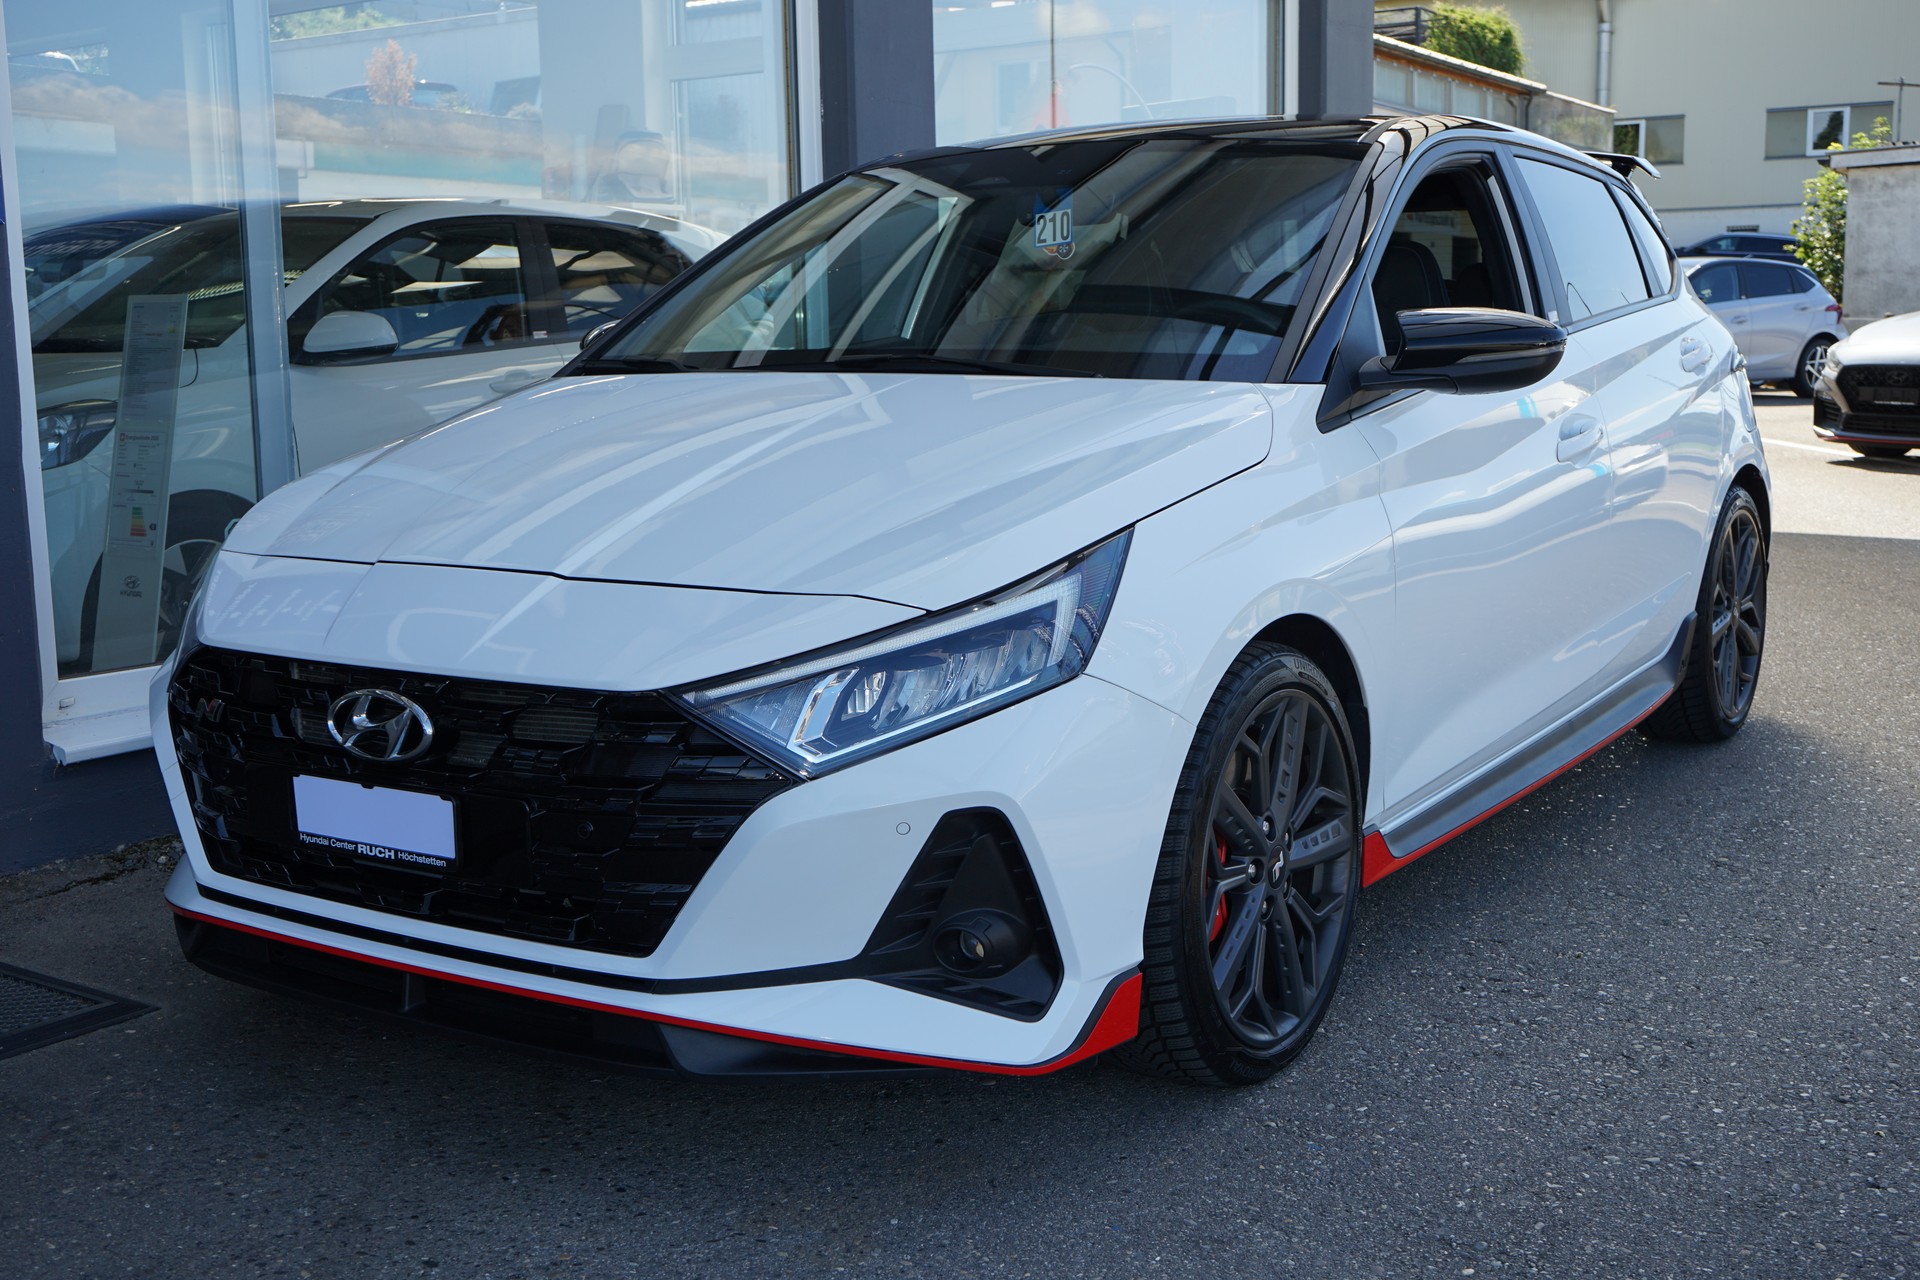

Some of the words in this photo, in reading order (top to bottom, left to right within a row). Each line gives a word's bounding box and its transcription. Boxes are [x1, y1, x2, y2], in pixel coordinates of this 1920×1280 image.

[1037, 211, 1070, 244] 210
[300, 833, 329, 846] Hyundai
[331, 838, 356, 850] Center
[357, 843, 395, 860] RUCH
[398, 851, 446, 867] Höchstetten
